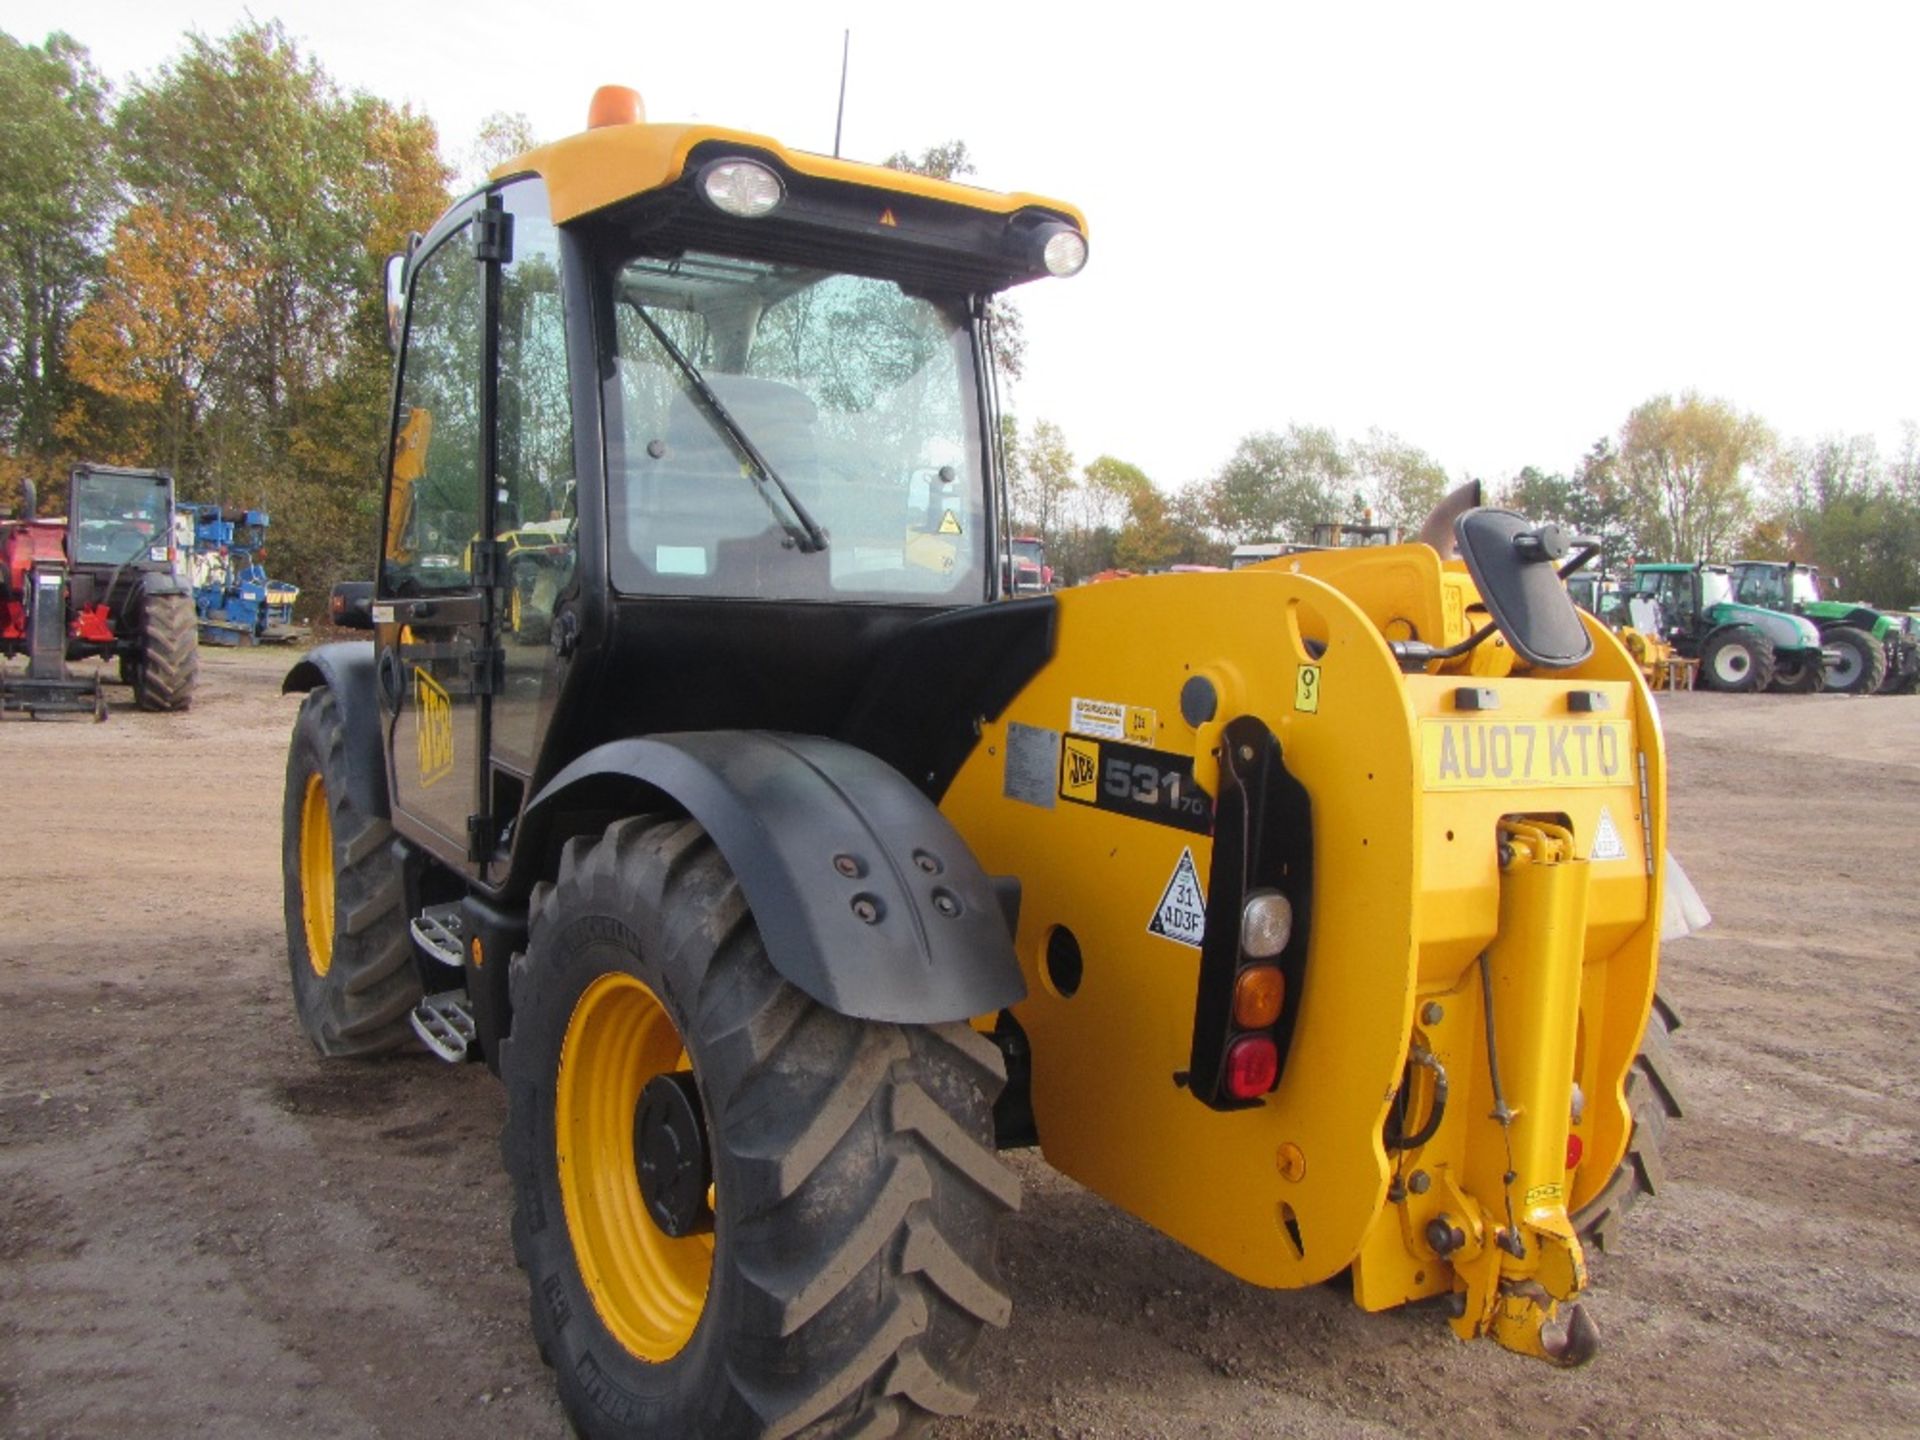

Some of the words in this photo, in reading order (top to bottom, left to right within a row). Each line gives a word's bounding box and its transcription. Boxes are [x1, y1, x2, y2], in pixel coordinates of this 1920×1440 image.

[419, 678, 451, 775] JCB
[1438, 724, 1537, 780] AU07
[1547, 724, 1620, 778] KTO
[1070, 752, 1095, 786] JCB
[1104, 757, 1182, 810] 531
[1175, 883, 1194, 908] 31
